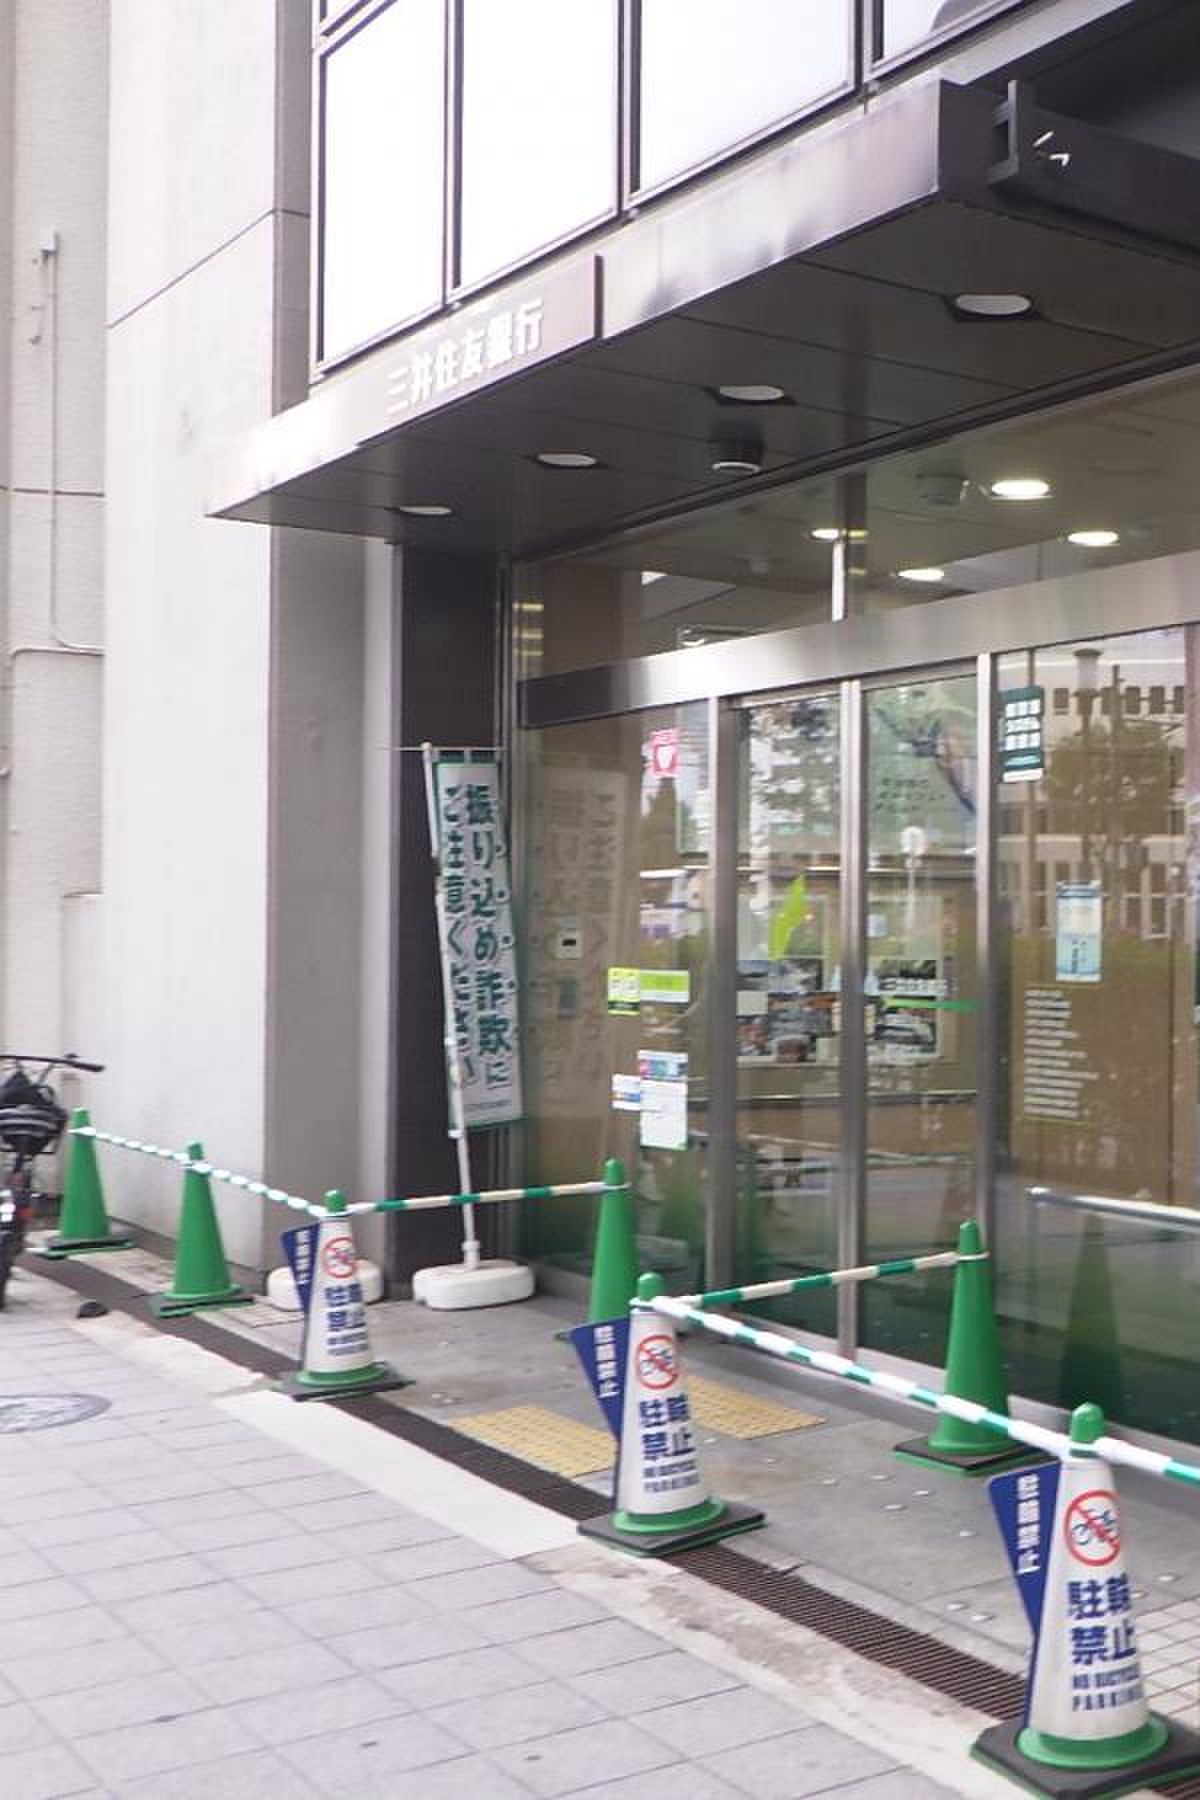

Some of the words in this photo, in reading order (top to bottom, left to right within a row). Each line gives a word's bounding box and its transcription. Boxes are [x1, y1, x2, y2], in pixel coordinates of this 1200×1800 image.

[387, 299, 544, 413] 三井住友銀行
